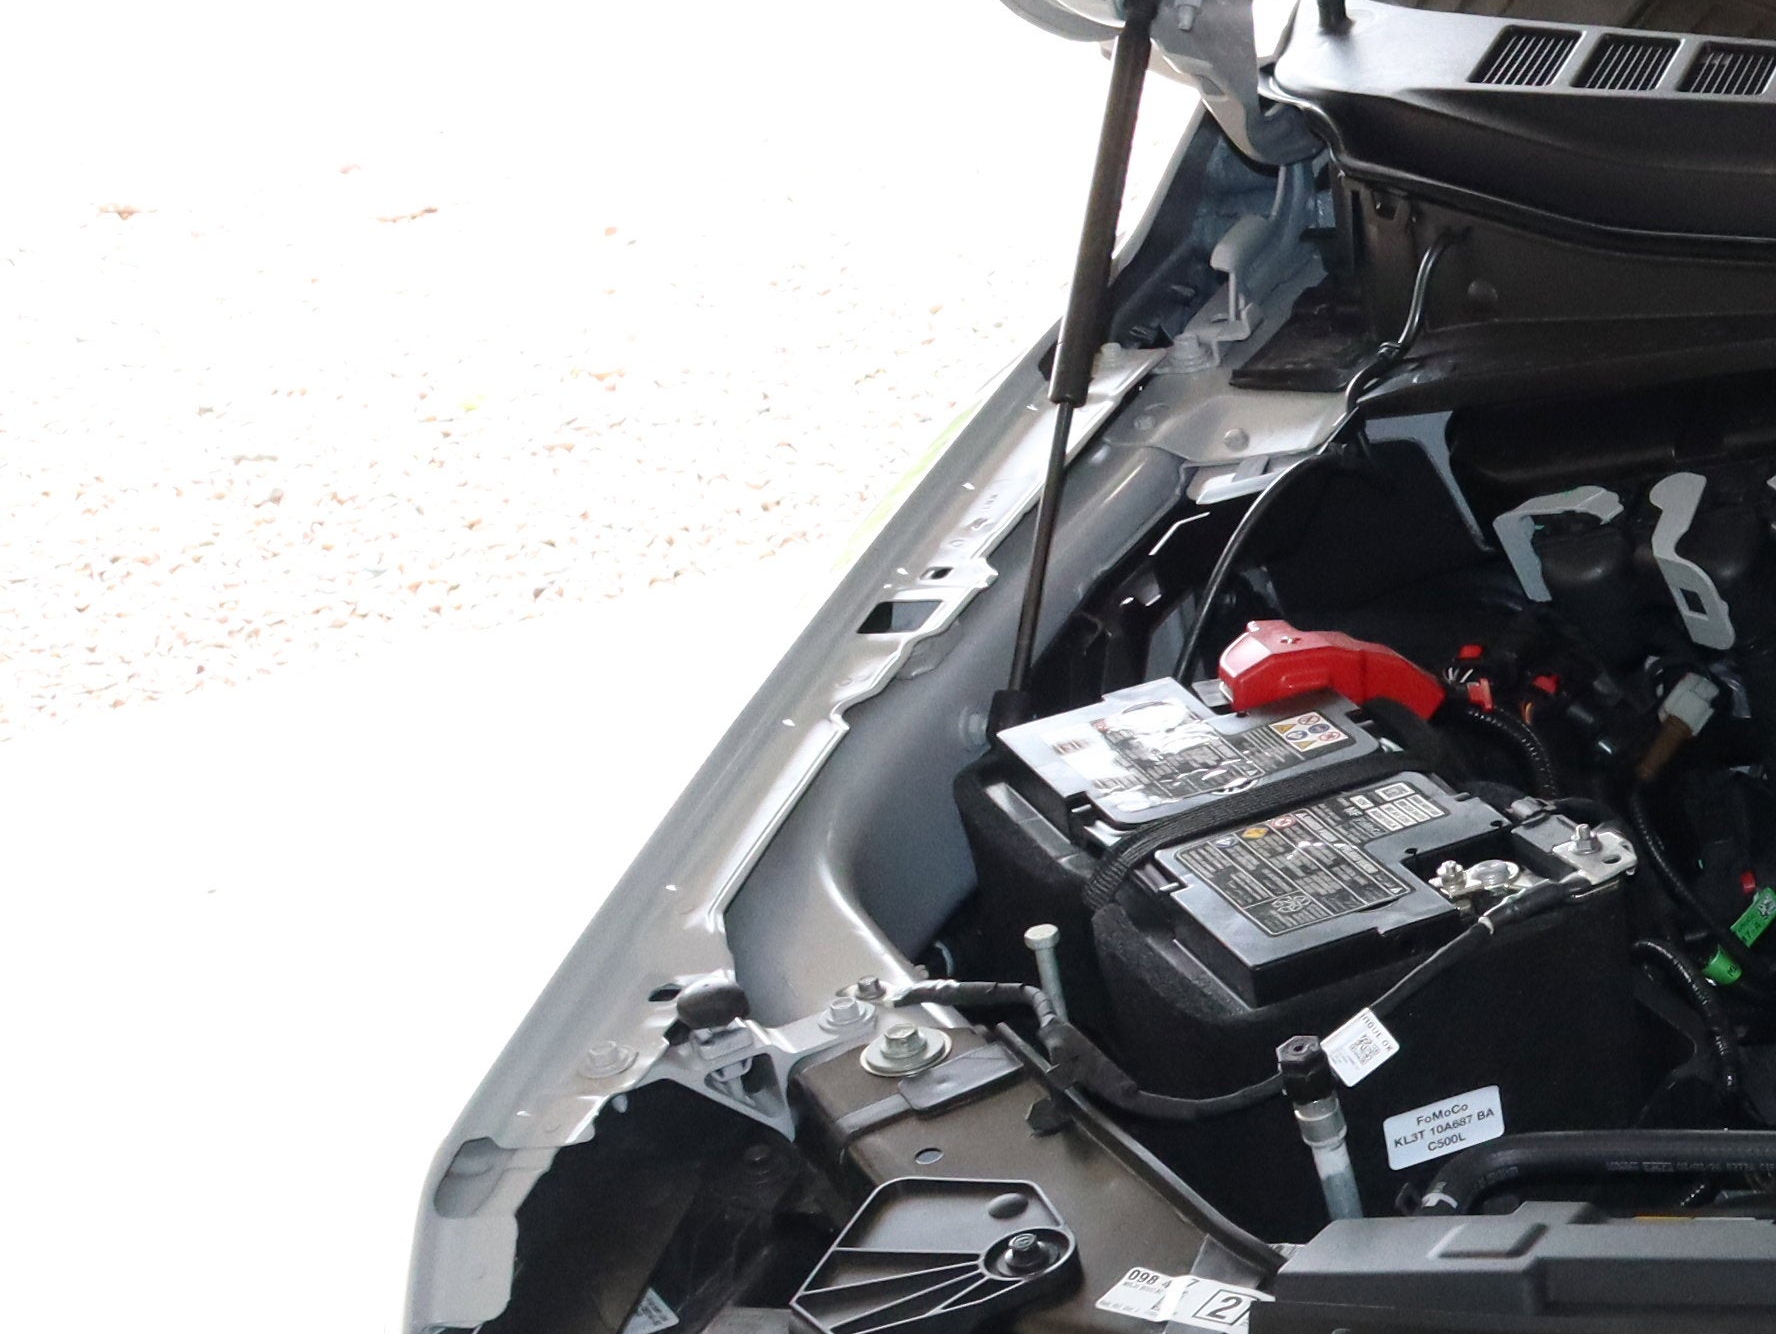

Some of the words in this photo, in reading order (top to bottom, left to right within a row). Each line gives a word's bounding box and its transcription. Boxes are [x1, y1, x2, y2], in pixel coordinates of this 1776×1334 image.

[1416, 1102, 1469, 1126] FoMoCo
[1393, 1130, 1426, 1148] KL3T
[1430, 1115, 1473, 1137] 10A687
[1476, 1108, 1496, 1121] BA
[1427, 1134, 1467, 1152] C500L
[1127, 1269, 1158, 1285] 098
[1206, 1296, 1243, 1319] 2
